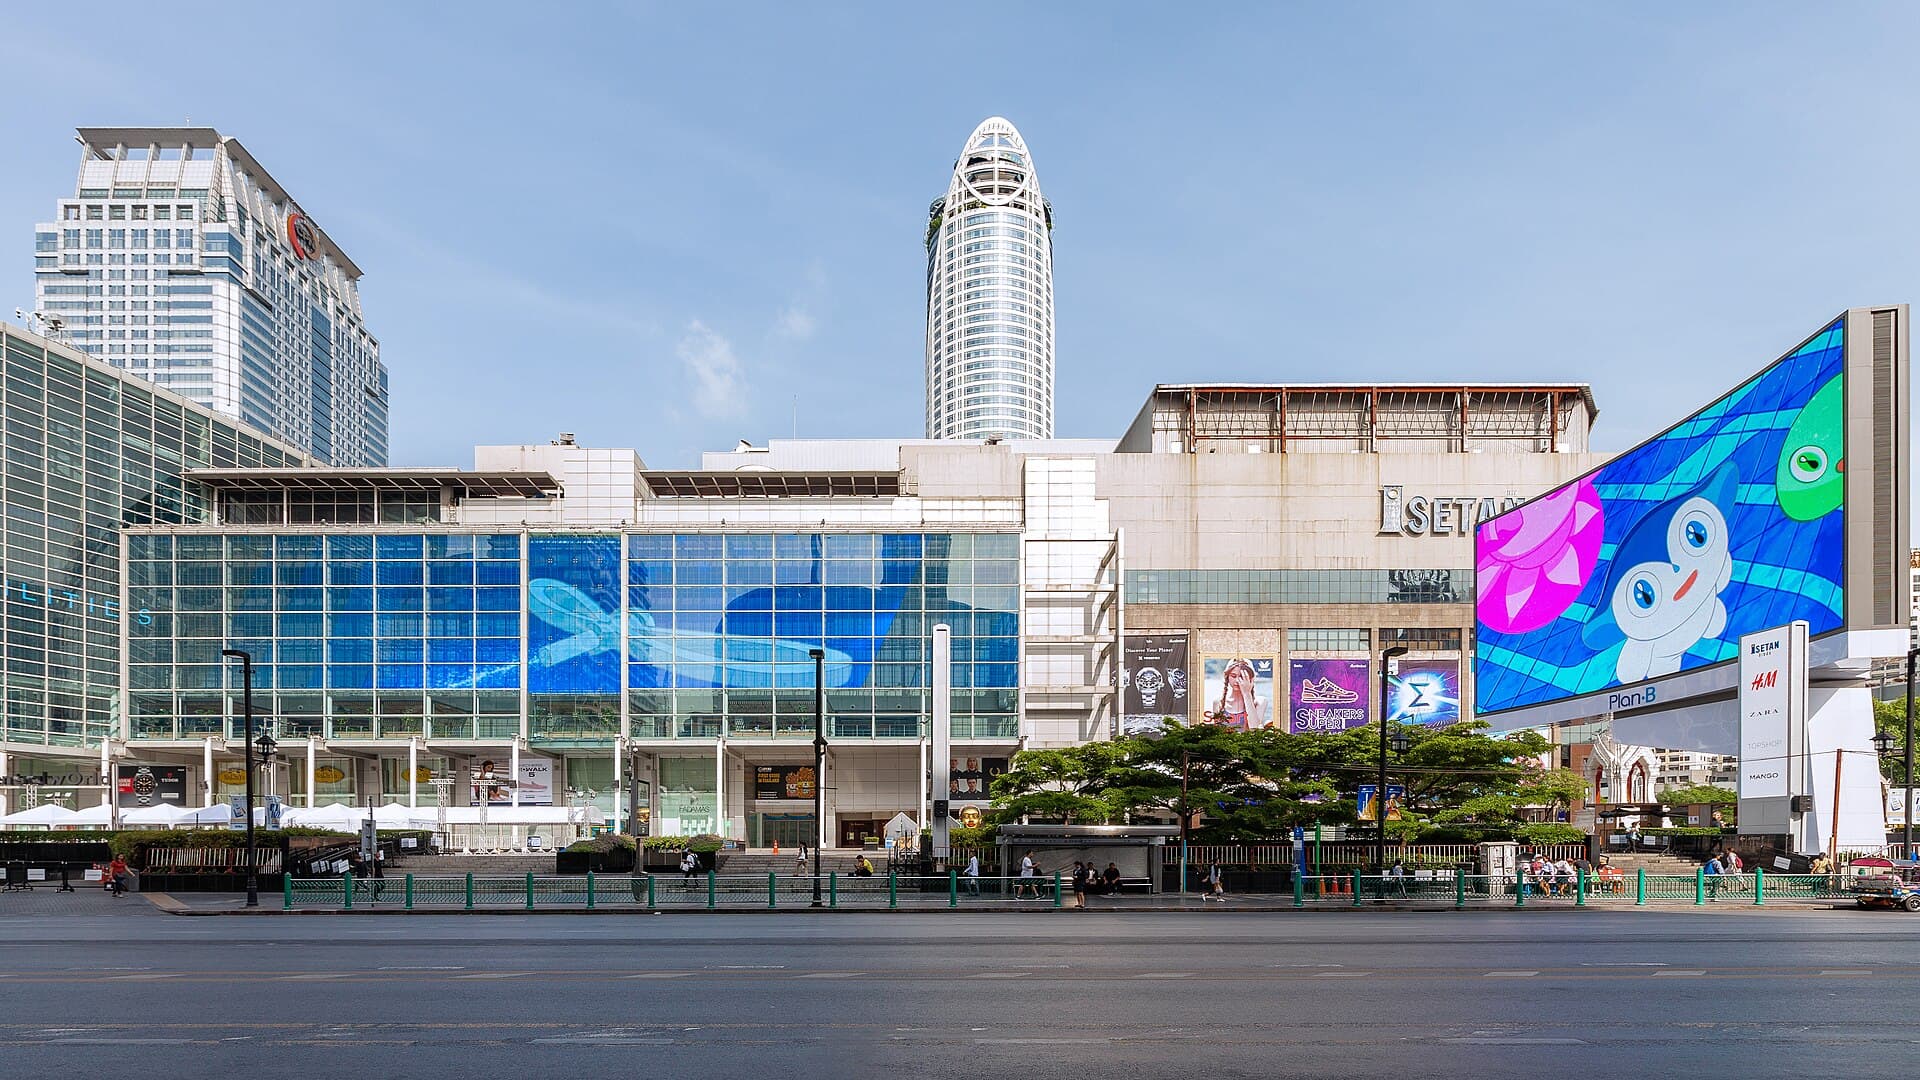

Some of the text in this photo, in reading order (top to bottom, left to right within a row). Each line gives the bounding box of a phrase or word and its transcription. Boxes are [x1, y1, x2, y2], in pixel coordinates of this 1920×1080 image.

[1751, 641, 1780, 655] ISETAN
[1751, 669, 1778, 691] H&M
[1203, 710, 1248, 727] Sart
[1296, 708, 1365, 722] SNEAKERS
[1749, 709, 1779, 718] ZARA
[1749, 772, 1779, 781] MANGO
